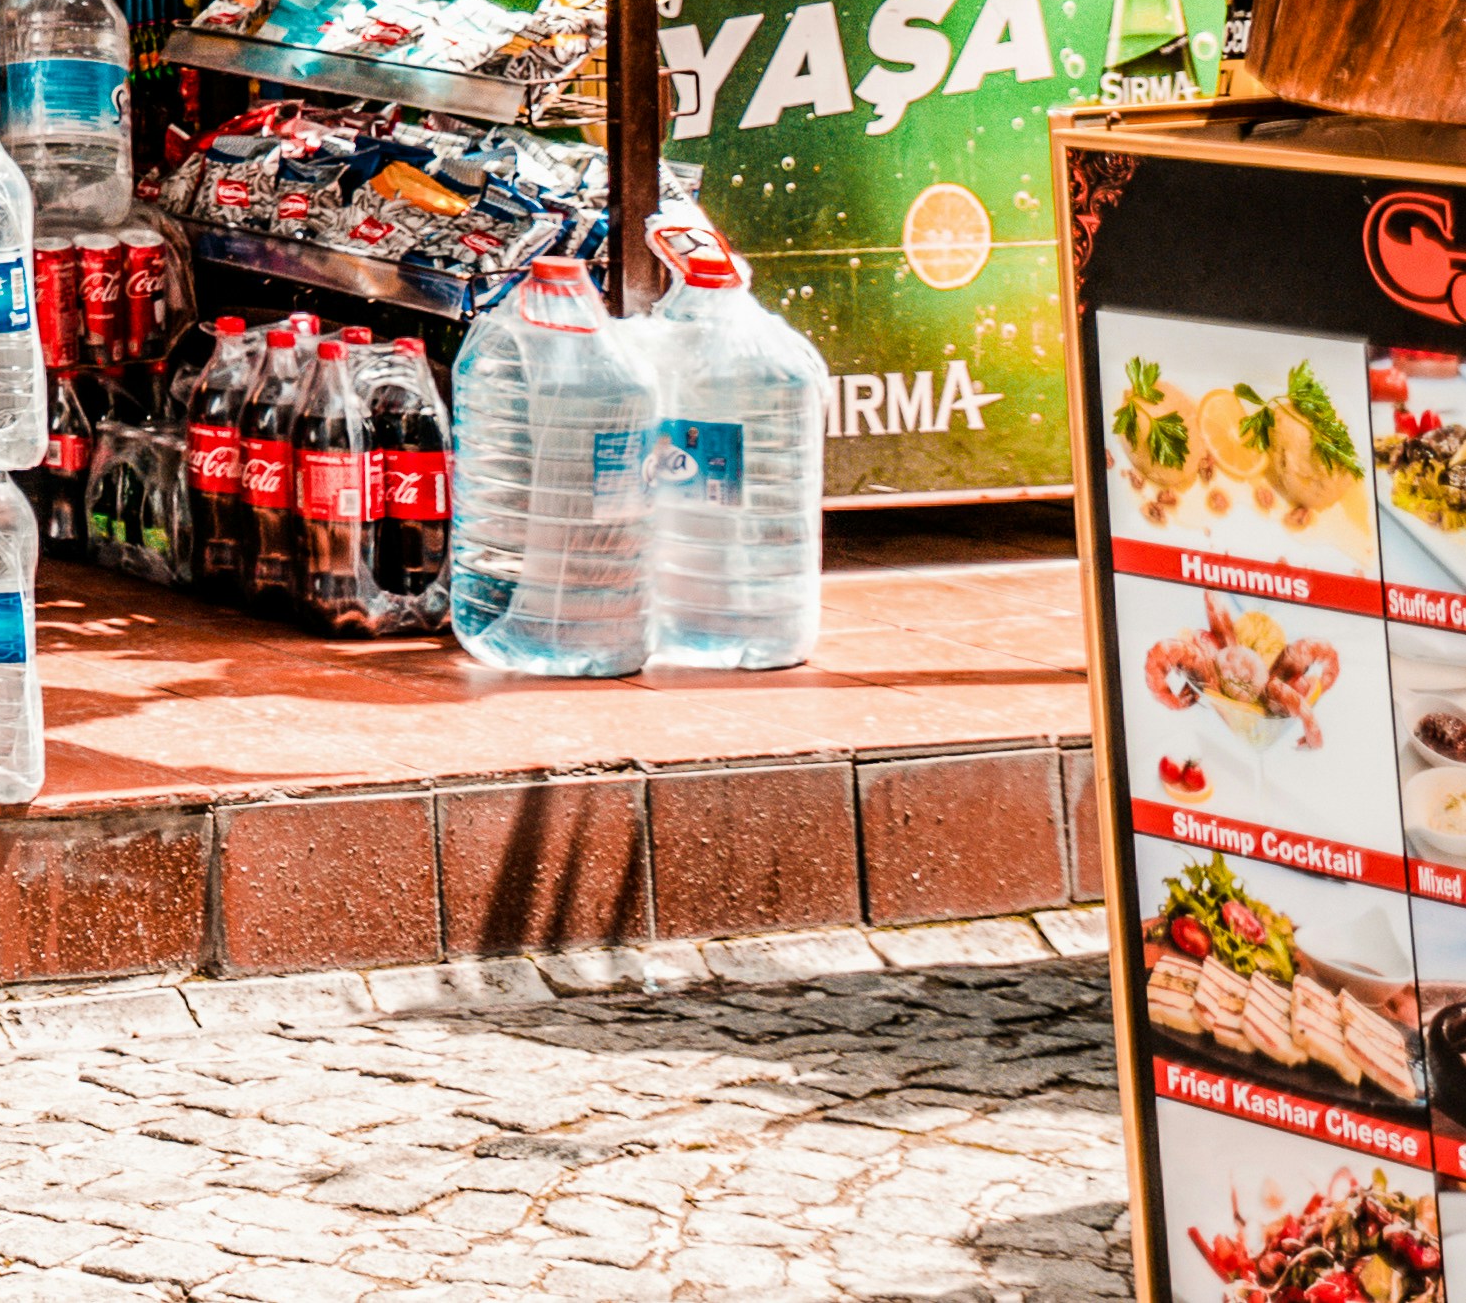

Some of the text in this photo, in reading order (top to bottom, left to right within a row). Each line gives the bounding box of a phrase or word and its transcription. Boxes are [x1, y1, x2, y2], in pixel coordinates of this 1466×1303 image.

[1101, 68, 1201, 106] SIRMA
[824, 360, 1003, 441] IRMA
[1180, 553, 1310, 599] Hummus
[1388, 588, 1436, 623] Stuffed
[1172, 811, 1363, 878] Shrimp Cocktail
[1417, 865, 1463, 901] Mixed
[1166, 1065, 1419, 1158] Fried Kashar Cheese
